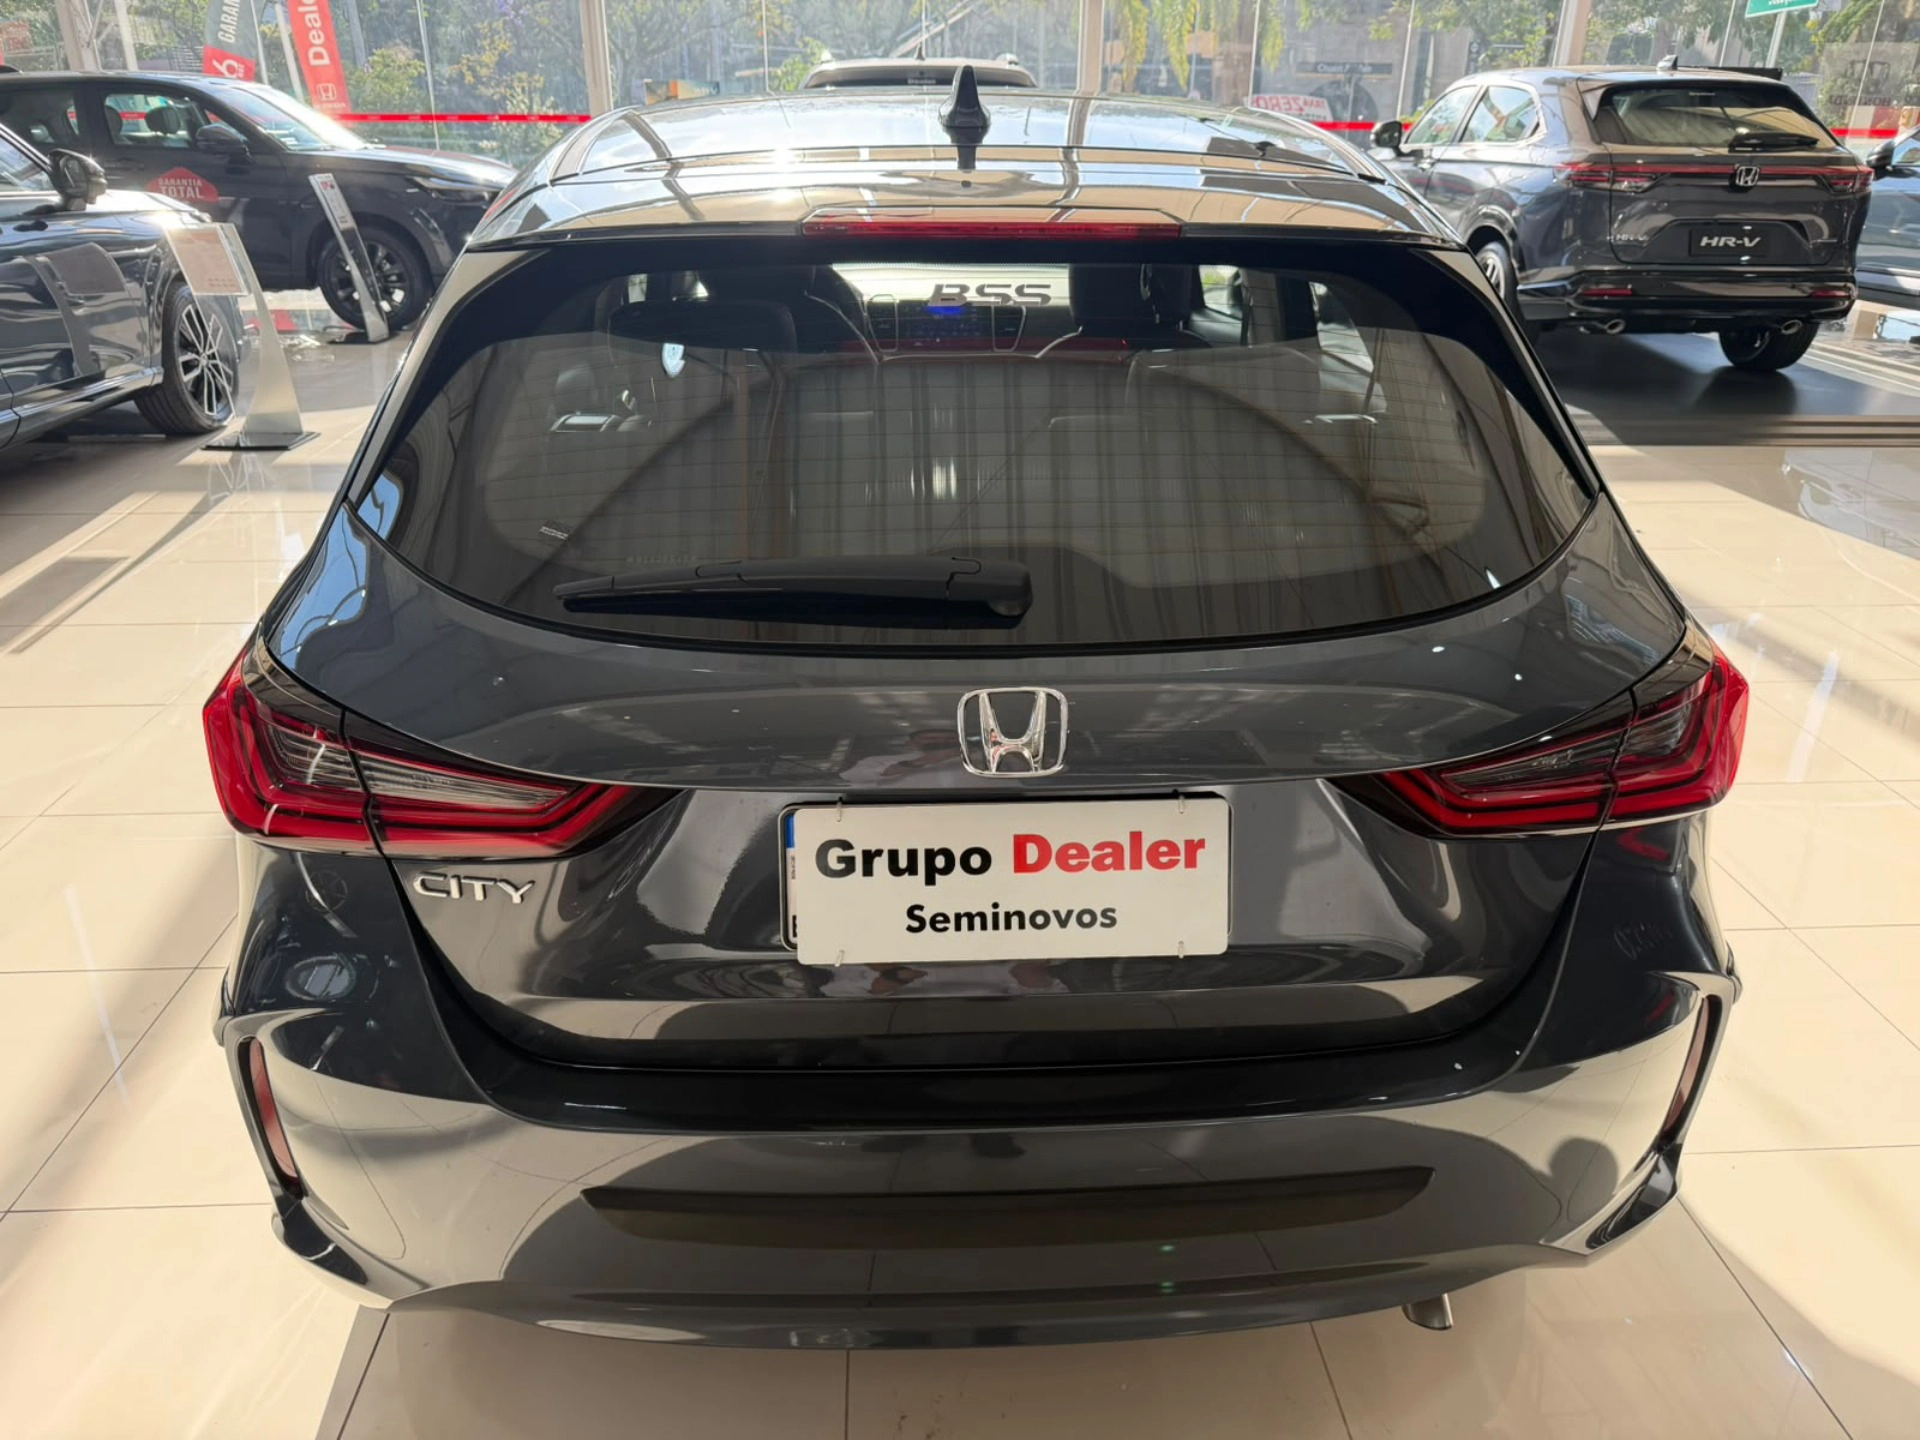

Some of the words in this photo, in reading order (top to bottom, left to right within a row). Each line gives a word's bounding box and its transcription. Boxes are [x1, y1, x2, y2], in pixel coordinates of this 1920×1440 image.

[160, 186, 205, 198] TOTAL
[1699, 235, 1761, 247] HR-V
[927, 283, 1052, 307] BSS
[814, 838, 992, 886] Grupo
[1013, 830, 1206, 874] Dealer
[413, 870, 536, 904] CITY
[905, 902, 1118, 933] Seminovos
